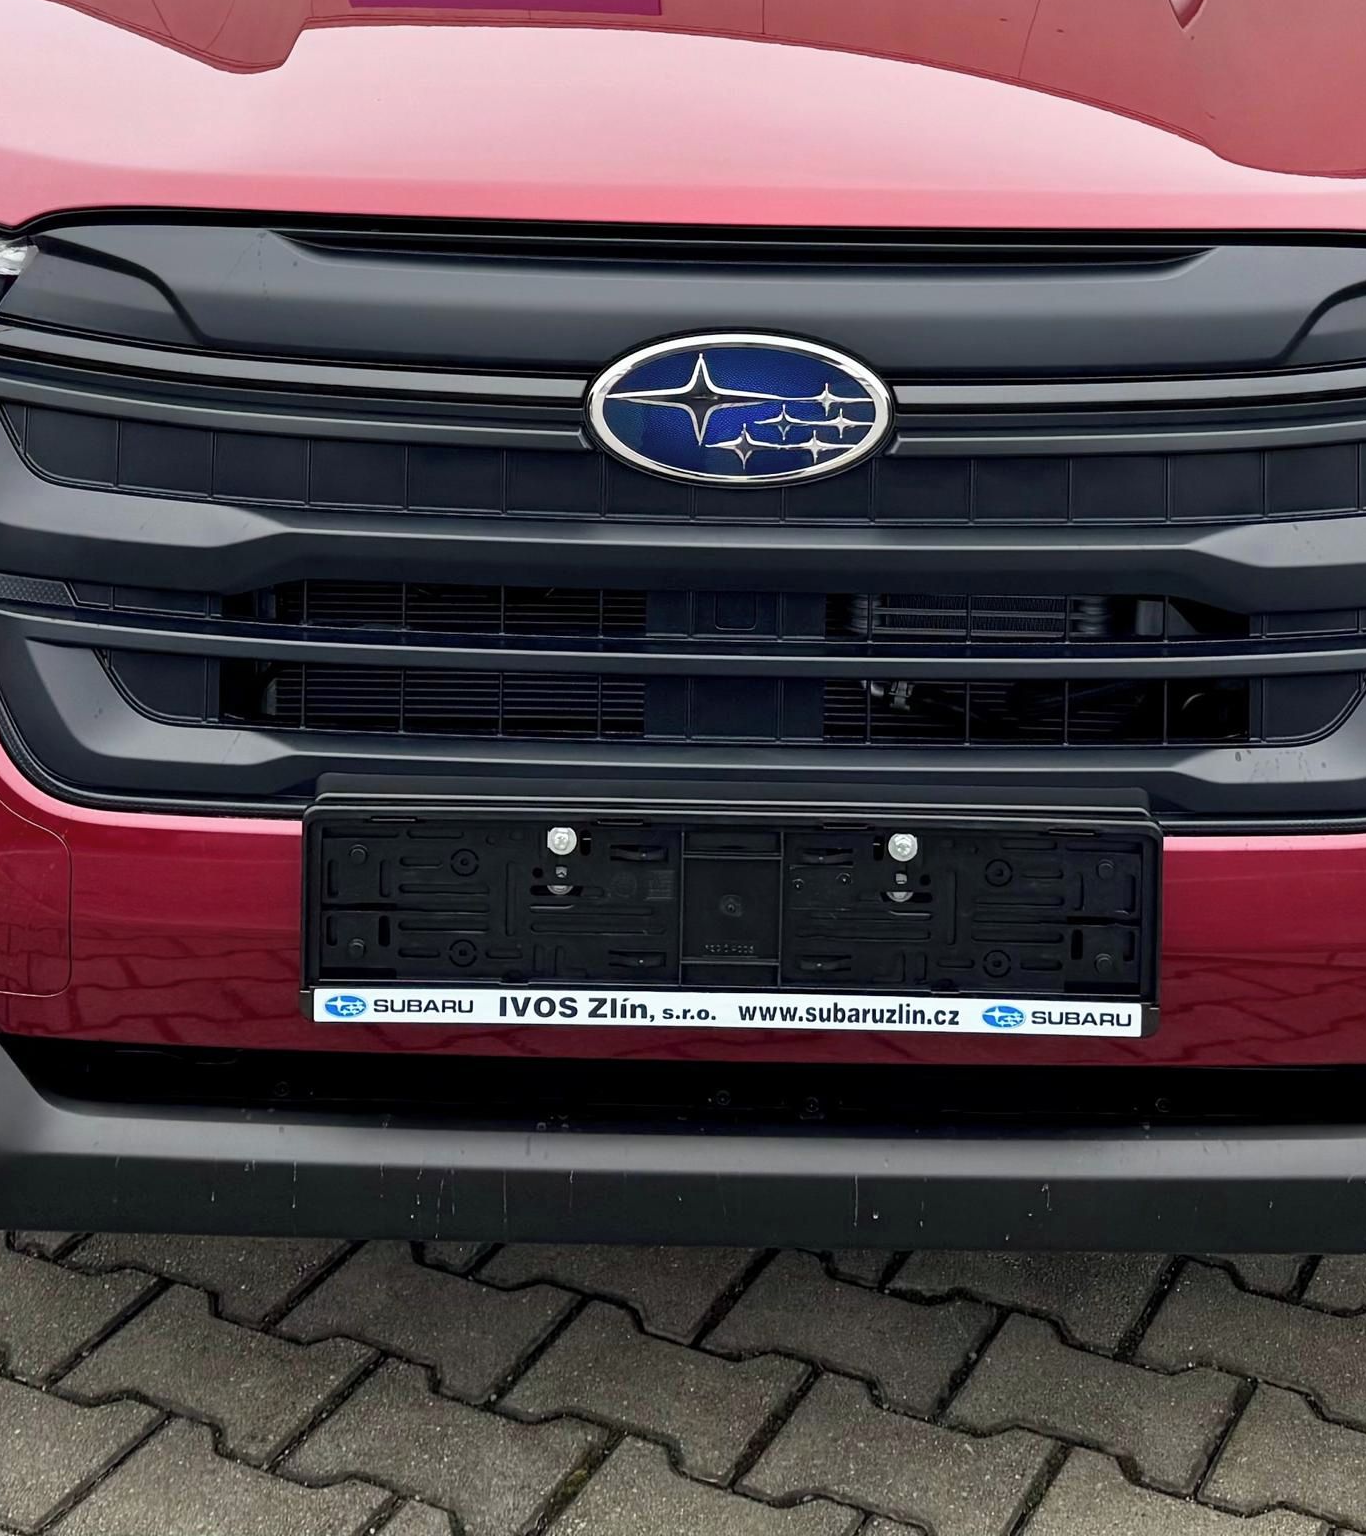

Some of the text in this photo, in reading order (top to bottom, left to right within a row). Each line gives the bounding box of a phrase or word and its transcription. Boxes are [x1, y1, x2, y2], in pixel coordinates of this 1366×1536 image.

[373, 996, 1132, 1027] SUBARU IVOS Zlín, s.r.o. www.subaruzlin.cz SUBARU
